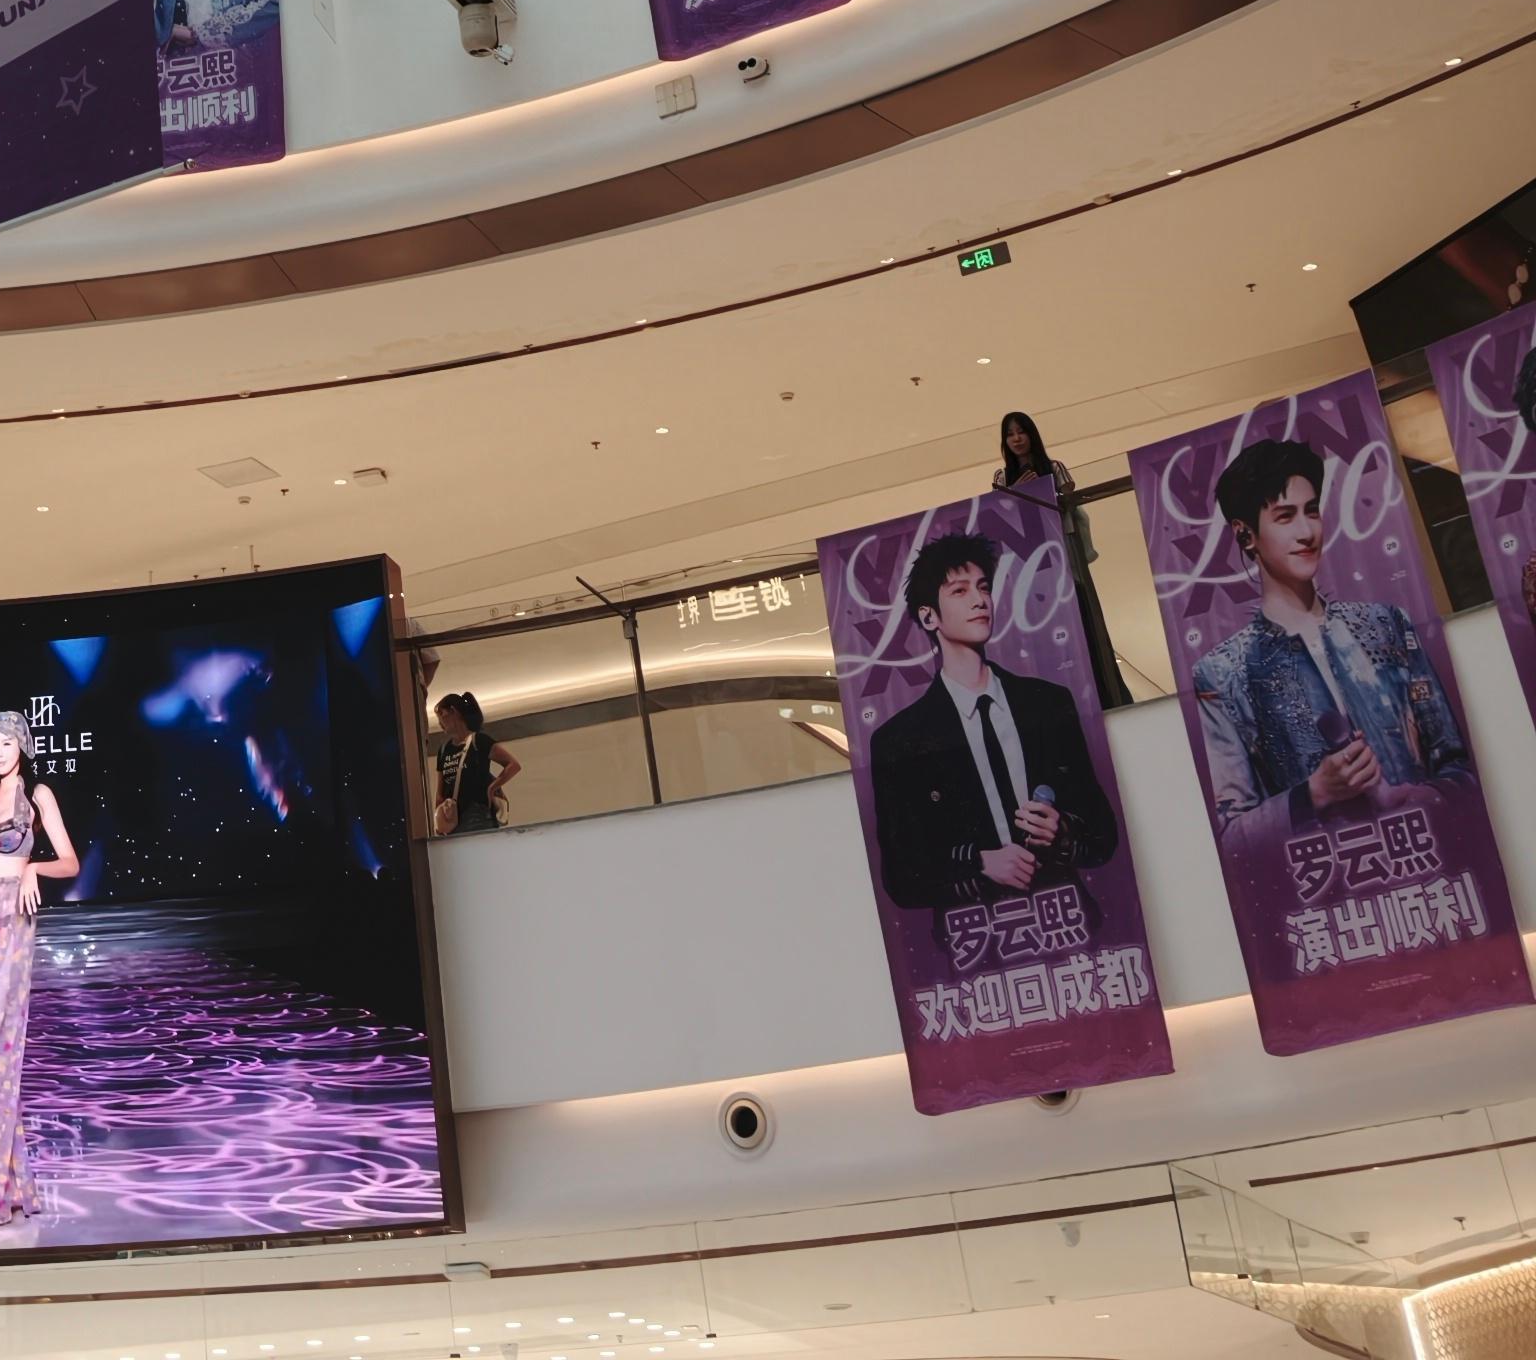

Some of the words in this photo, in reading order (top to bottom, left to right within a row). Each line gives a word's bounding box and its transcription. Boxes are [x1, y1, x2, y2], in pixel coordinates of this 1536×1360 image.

[159, 85, 257, 132] 出顺利
[160, 49, 237, 94] 云熙
[1285, 808, 1442, 902] 罗云熙
[945, 884, 1089, 970] 罗云熙
[1286, 872, 1487, 973] 演出顺利
[915, 945, 1150, 1042] 欢迎回成都
